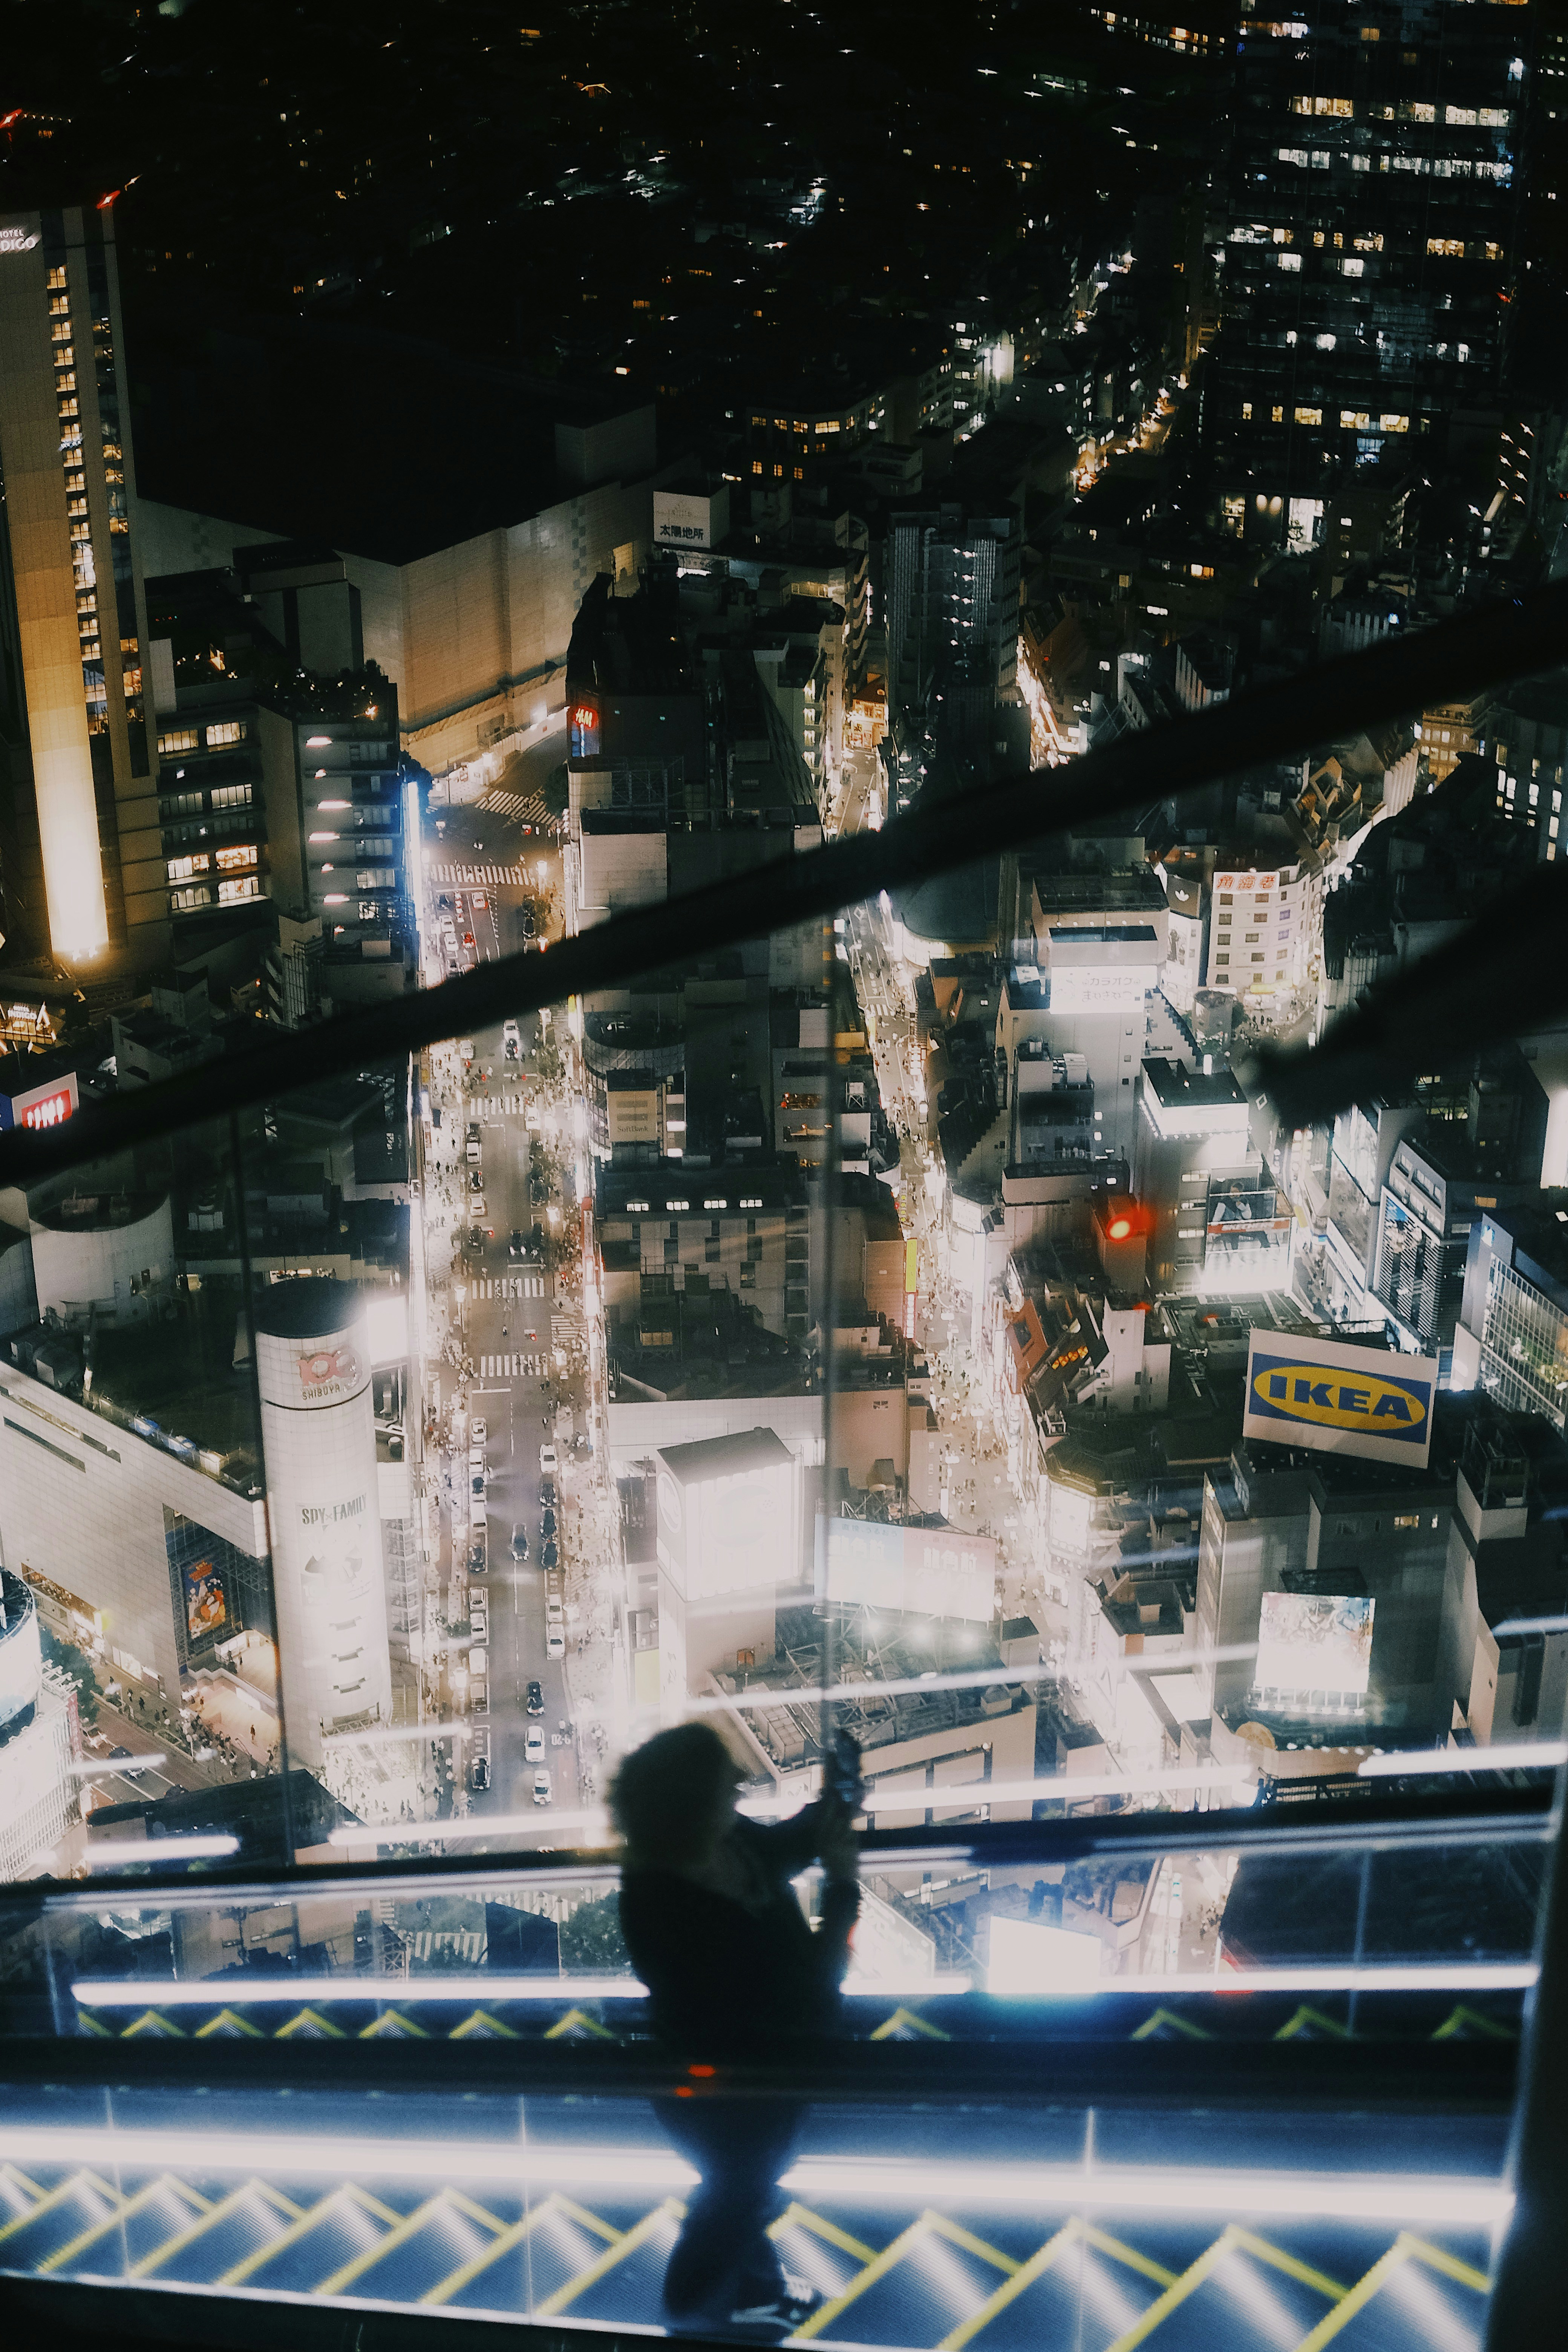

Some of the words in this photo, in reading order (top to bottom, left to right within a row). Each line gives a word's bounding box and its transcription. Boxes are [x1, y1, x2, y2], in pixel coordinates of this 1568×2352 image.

[0, 237, 36, 251] DIGO
[1216, 875, 1276, 890] 角海老
[1090, 977, 1133, 986] カラオケ
[8, 1010, 37, 1020] INDIGO
[296, 1346, 362, 1390] 109
[302, 1384, 340, 1400] SHIBUYA
[1269, 1374, 1413, 1423] IKEA
